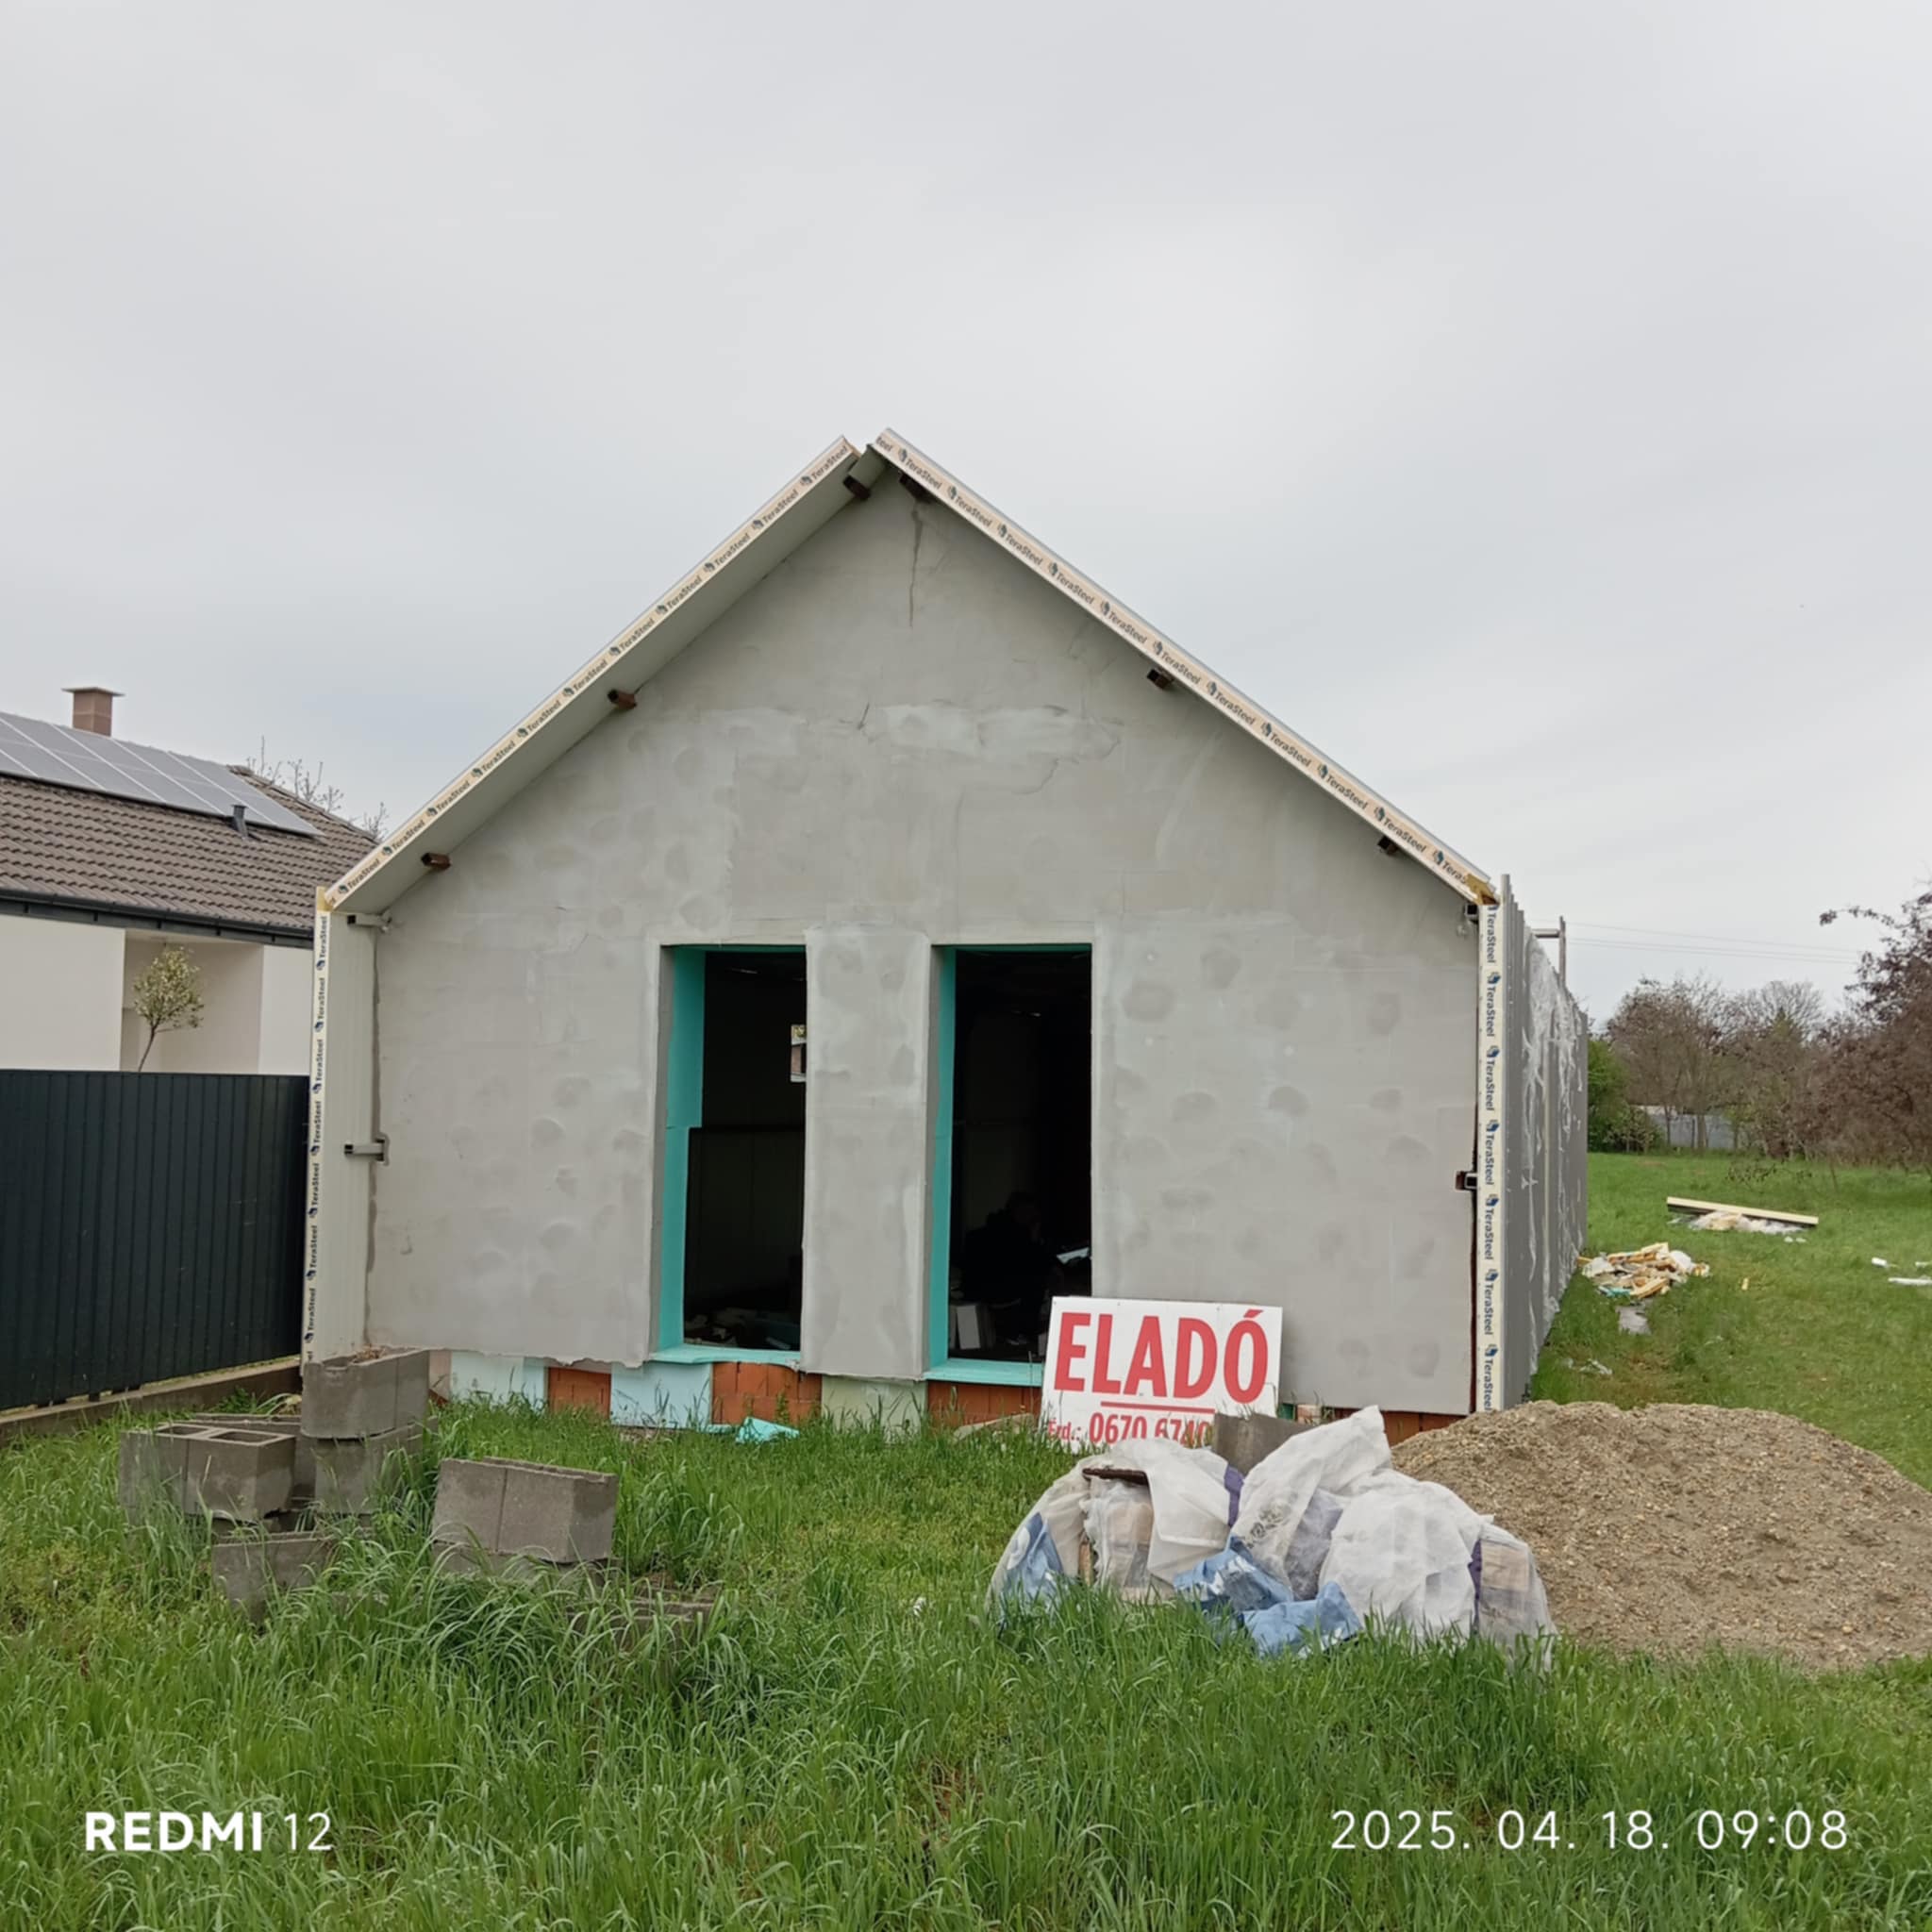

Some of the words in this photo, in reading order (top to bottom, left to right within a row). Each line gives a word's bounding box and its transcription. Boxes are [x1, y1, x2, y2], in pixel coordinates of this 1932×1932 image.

[348, 859, 381, 891] TeraSteel
[392, 820, 425, 852] TeraSteel
[437, 781, 471, 812] TeraSteel
[481, 741, 516, 774] TeraSteel
[526, 700, 561, 733] TeraSteel
[573, 660, 608, 693] TeraSteel
[619, 619, 656, 652] TeraSteel
[666, 576, 703, 610] TeraSteel
[714, 533, 751, 568] TeraSteel
[762, 490, 799, 525] TeraSteel
[811, 445, 849, 481] TeraSteel
[906, 458, 942, 491] TeraSteel
[956, 496, 992, 528] TeraSteel
[1006, 534, 1043, 567] TeraSteel
[1057, 572, 1095, 606] TeraSteel
[1108, 611, 1148, 645] TeraSteel
[1161, 651, 1201, 685] TeraSteel
[1215, 691, 1257, 725] TeraSteel
[1270, 732, 1311, 768] TeraSteel
[1326, 774, 1369, 811] TeraSteel
[1383, 817, 1427, 854] TeraSteel
[319, 916, 327, 958] TeraSteel
[1487, 913, 1497, 964] TeraSteel
[317, 977, 325, 1020] TeraSteel
[1486, 987, 1496, 1037] TeraSteel
[1486, 1061, 1495, 1111] TeraSteel
[311, 1163, 320, 1207] TeraSteel
[1485, 1135, 1494, 1186] TeraSteel
[309, 1225, 318, 1269] TeraSteel
[1484, 1208, 1494, 1259] TeraSteel
[308, 1289, 316, 1331] TeraSteel
[1484, 1285, 1493, 1335] TeraSteel
[1054, 1309, 1268, 1404] ELADÓ
[1484, 1359, 1493, 1411] TeraSteel
[1090, 1412, 1148, 1444] 0670
